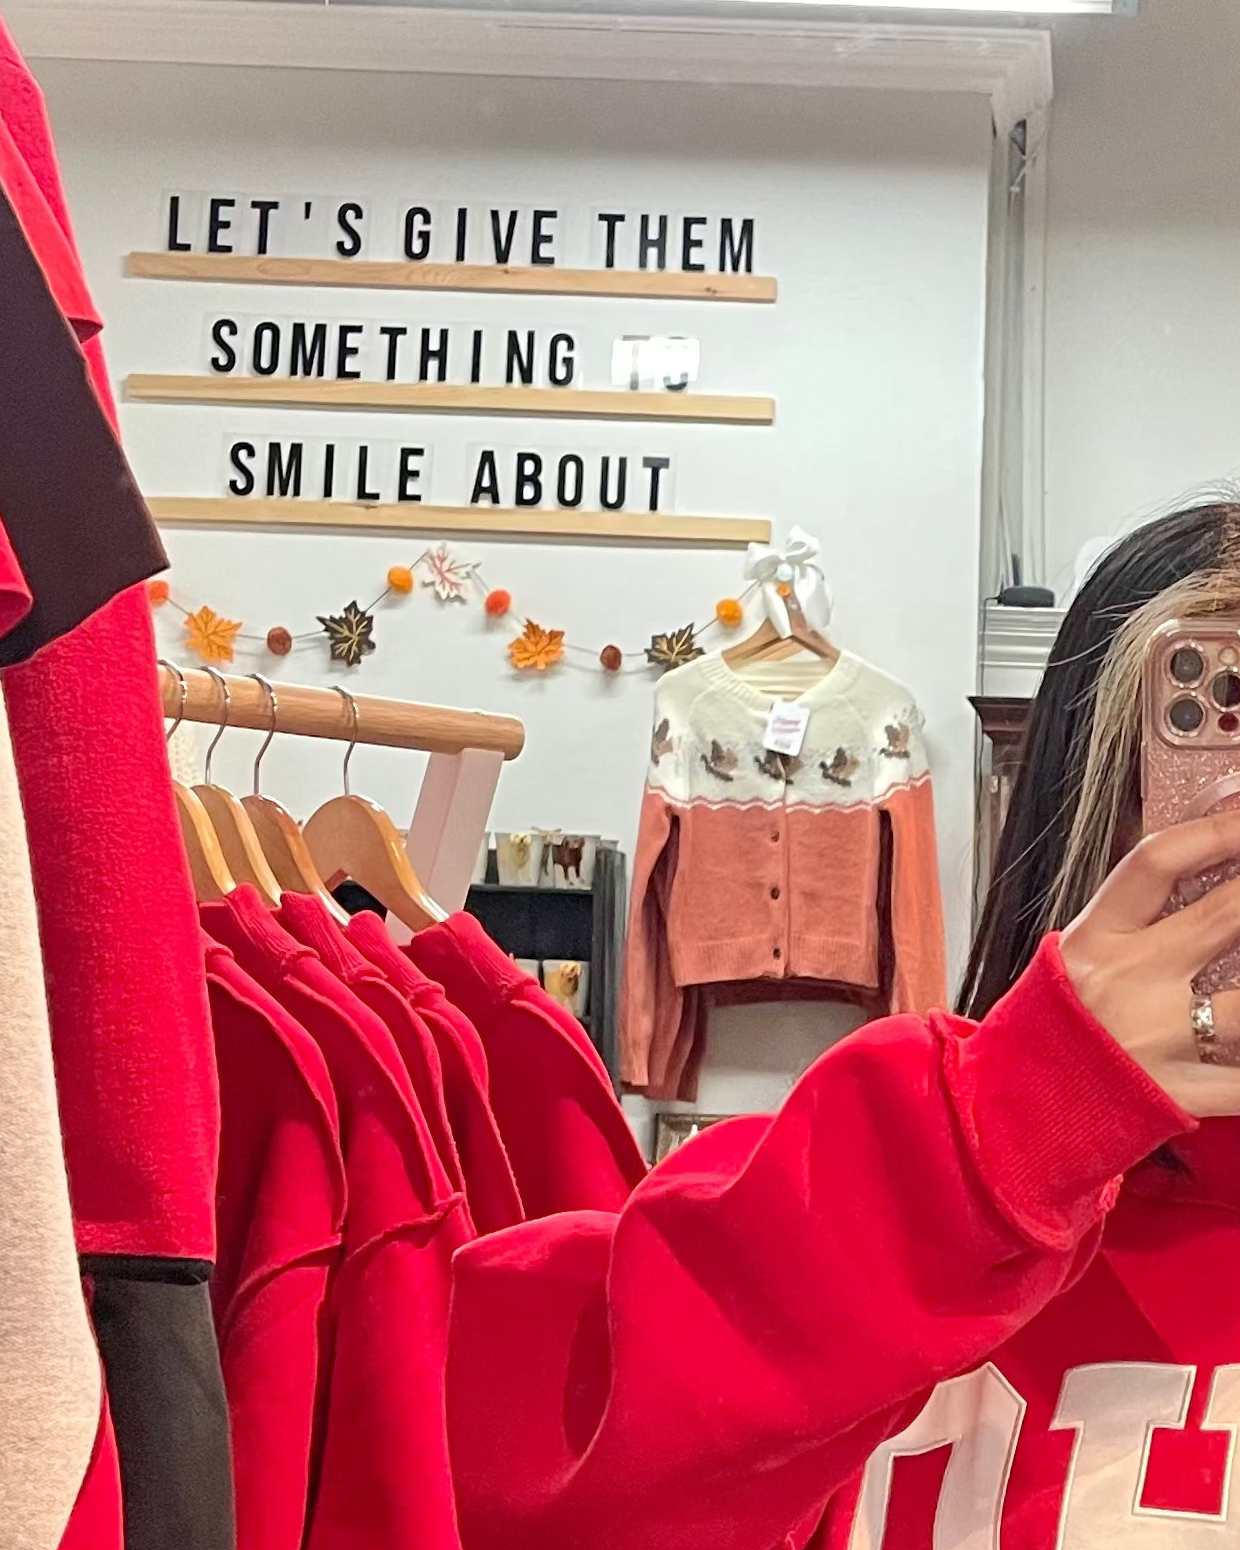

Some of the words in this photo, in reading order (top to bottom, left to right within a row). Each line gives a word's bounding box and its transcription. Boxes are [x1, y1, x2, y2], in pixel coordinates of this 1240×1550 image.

[167, 195, 364, 258] LET'S
[403, 206, 558, 266] GIVE
[597, 213, 754, 274] THEM
[210, 318, 575, 387] SOMETHING
[228, 441, 425, 503] SMILE
[470, 450, 670, 512] ABOUT
